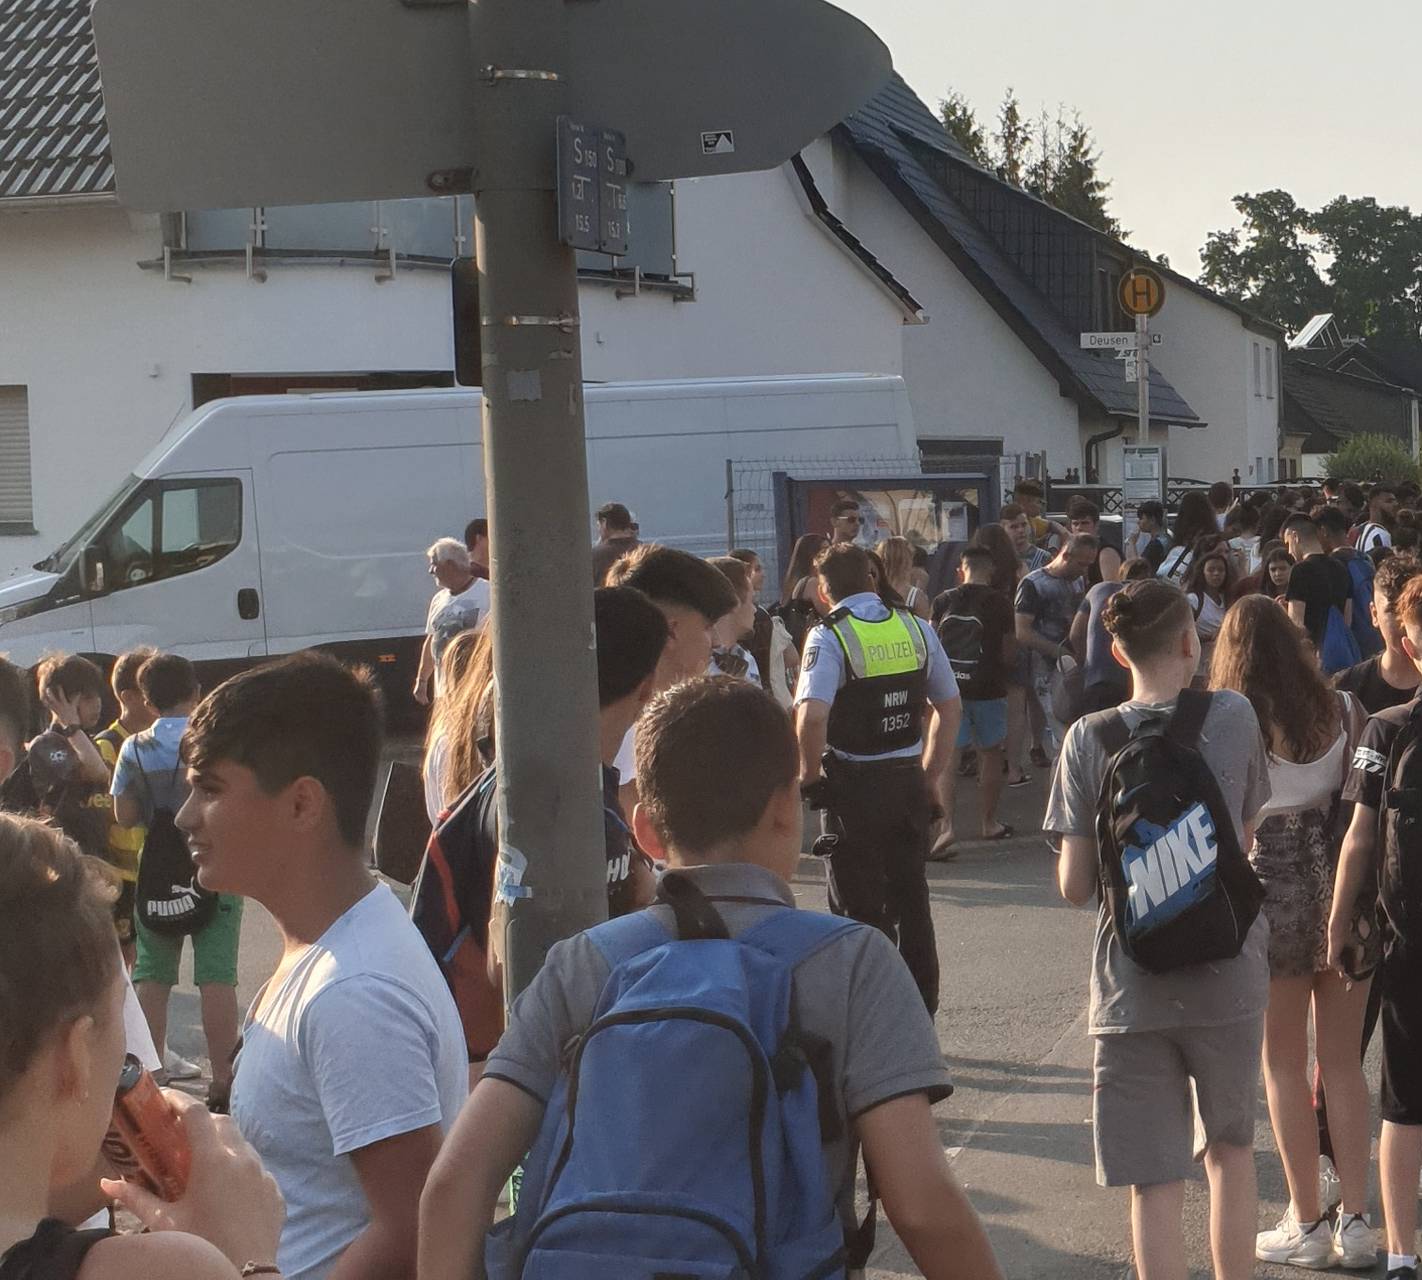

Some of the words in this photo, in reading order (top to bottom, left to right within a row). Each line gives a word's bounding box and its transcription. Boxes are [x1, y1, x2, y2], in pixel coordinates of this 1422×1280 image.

[1132, 279, 1151, 307] H
[1090, 335, 1128, 346] Deusen
[868, 641, 913, 662] POLIZEI
[884, 690, 908, 708] NRW
[881, 713, 910, 733] 1352
[1129, 804, 1218, 919] NIKE
[147, 894, 195, 916] PUMA
